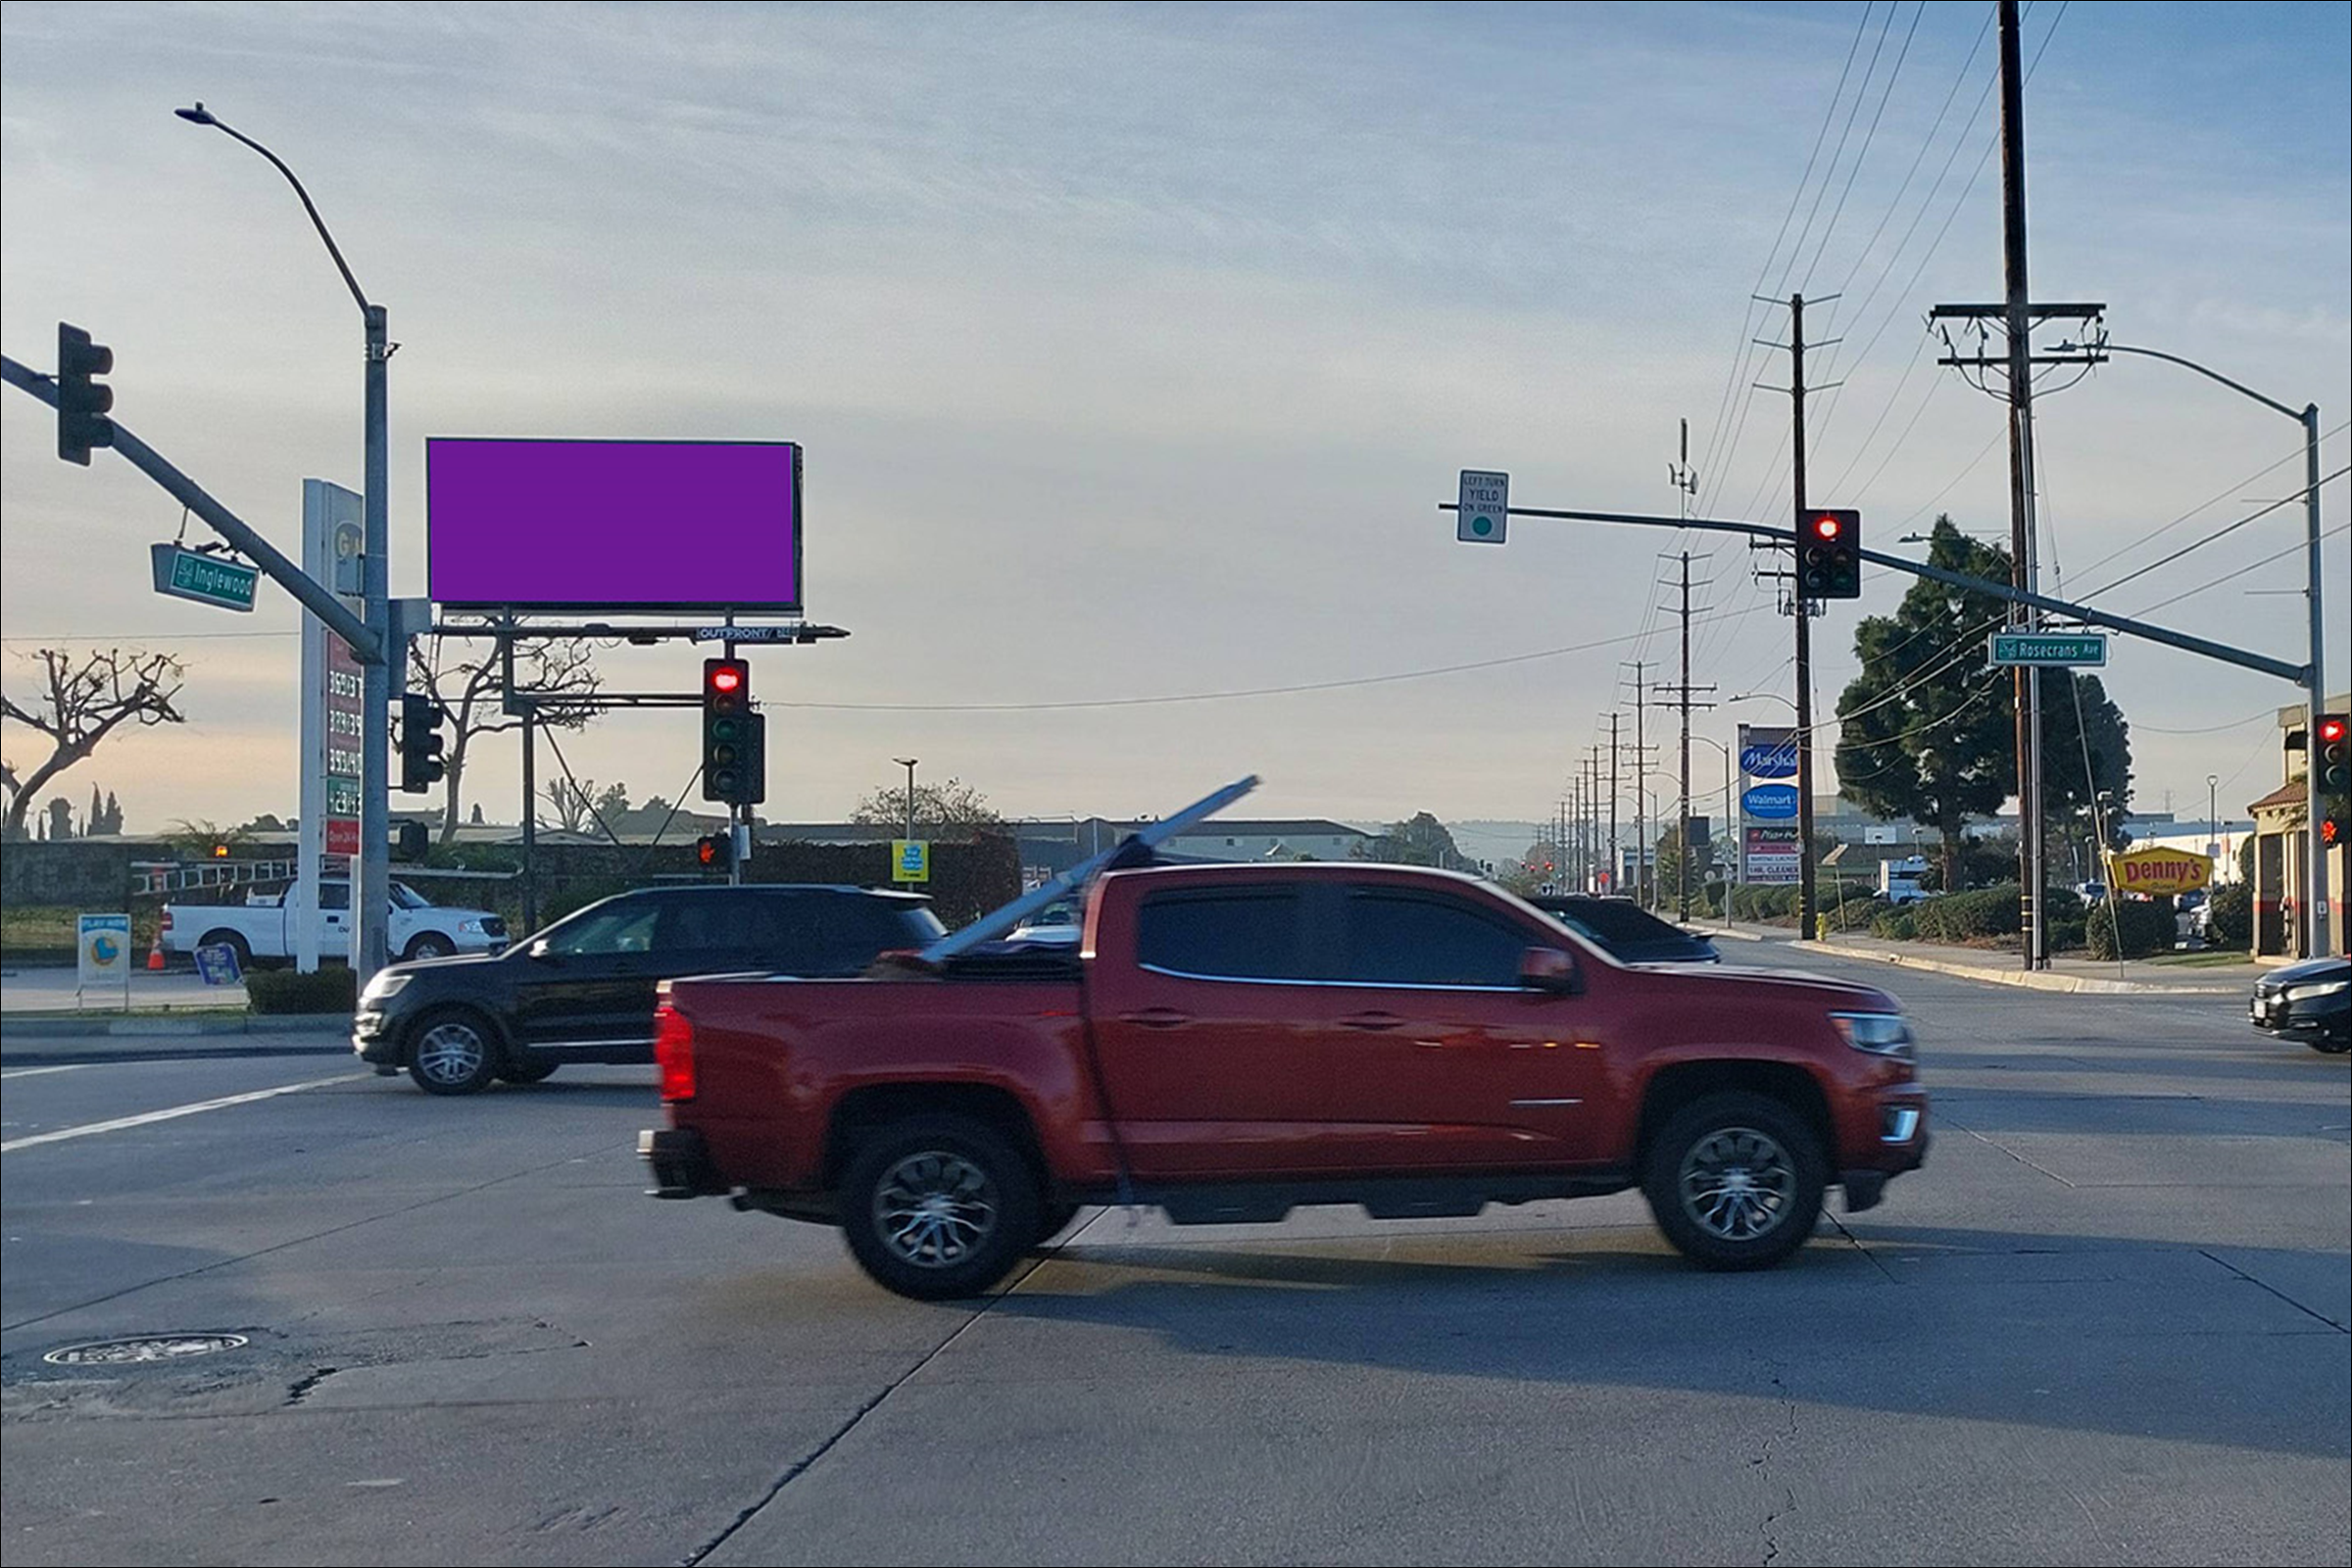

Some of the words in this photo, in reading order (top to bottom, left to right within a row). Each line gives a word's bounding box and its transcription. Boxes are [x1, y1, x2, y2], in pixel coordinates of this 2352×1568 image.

[1463, 475, 1483, 487] LEFT
[1485, 476, 1504, 487] TURN
[1469, 489, 1499, 502] YIELD
[1477, 503, 1502, 514] GREEN
[194, 563, 253, 597] Inglewood
[2019, 642, 2078, 659] Rosecrans
[2082, 643, 2099, 656] Ave
[1743, 751, 1797, 766] Marshal
[1746, 794, 1791, 805] Walmart
[2124, 858, 2203, 883] Denny's
